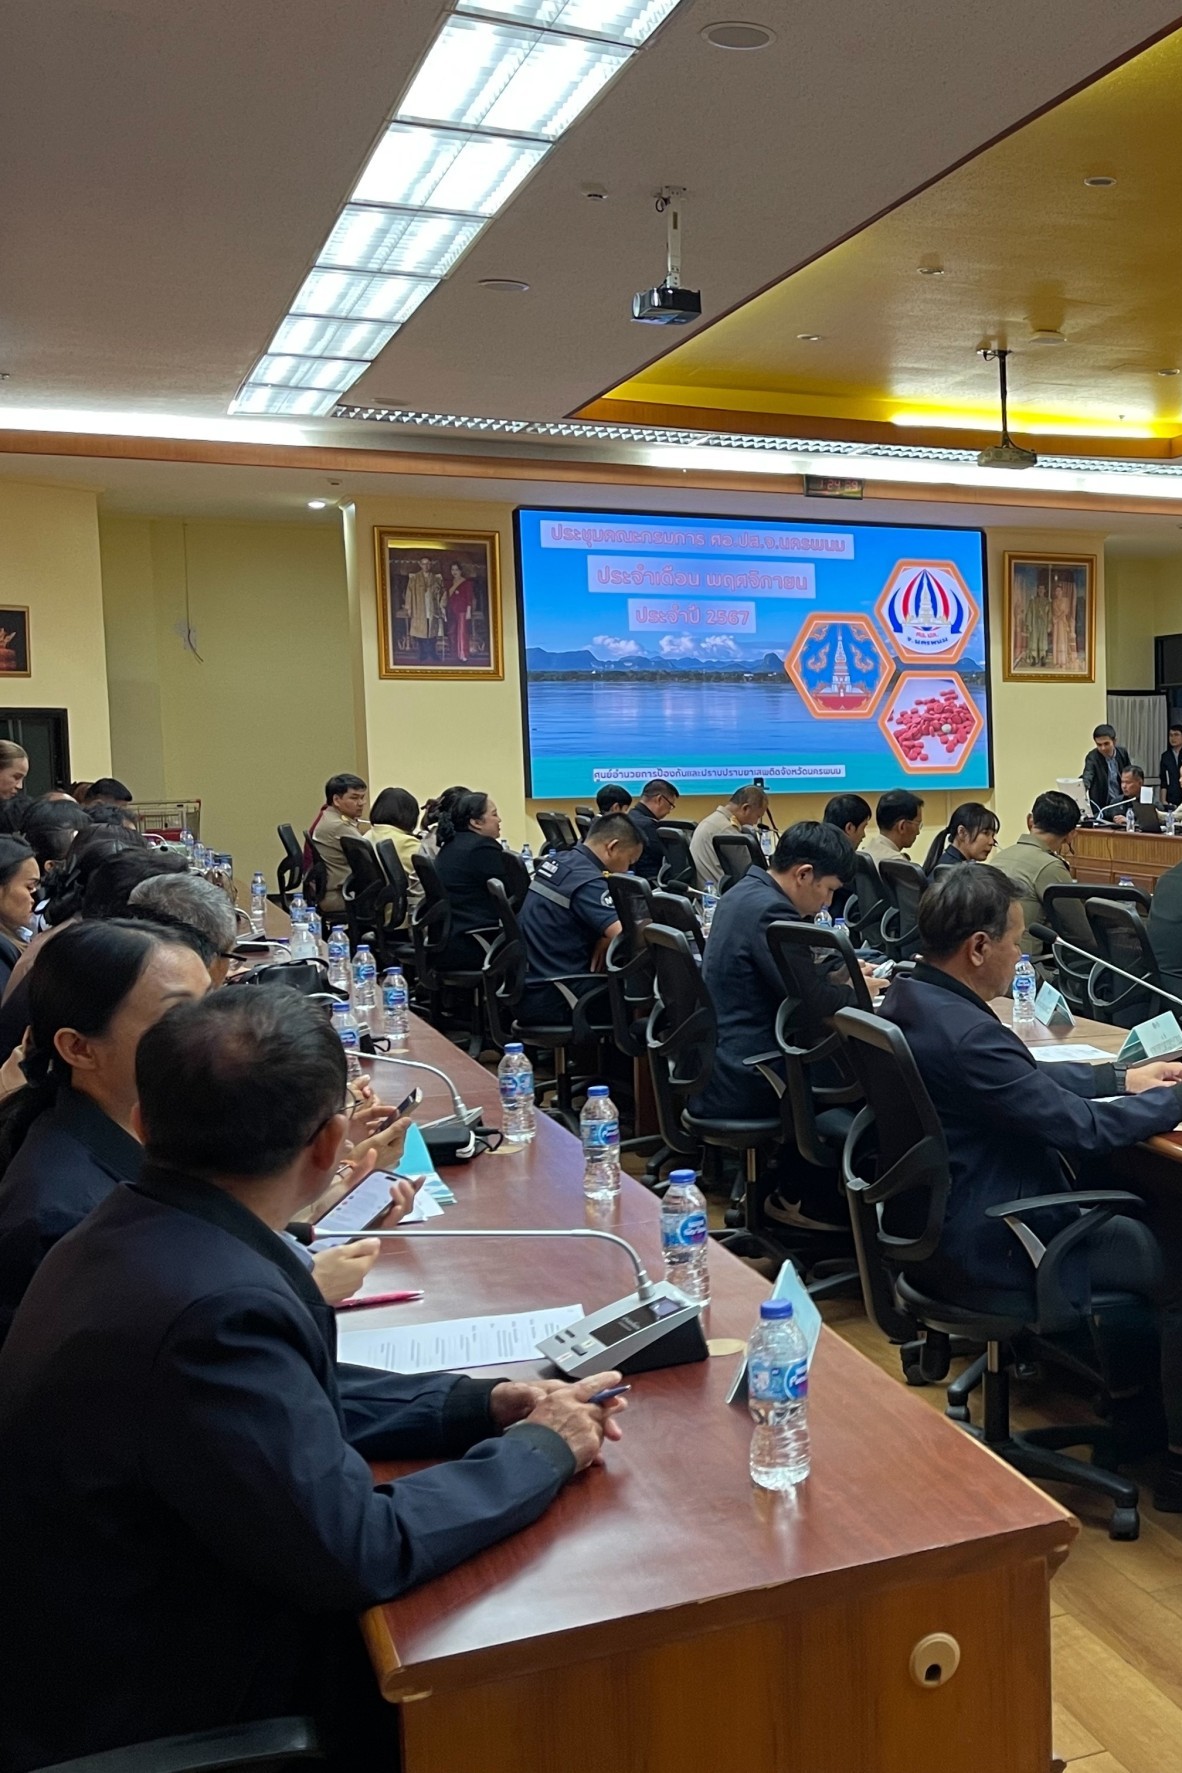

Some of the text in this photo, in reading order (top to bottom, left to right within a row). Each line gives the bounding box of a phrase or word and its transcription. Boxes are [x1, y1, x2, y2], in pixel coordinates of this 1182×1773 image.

[596, 563, 808, 591] ประจำเดือน พฤศจิกายน
[635, 604, 750, 626] ประจำปี 2567
